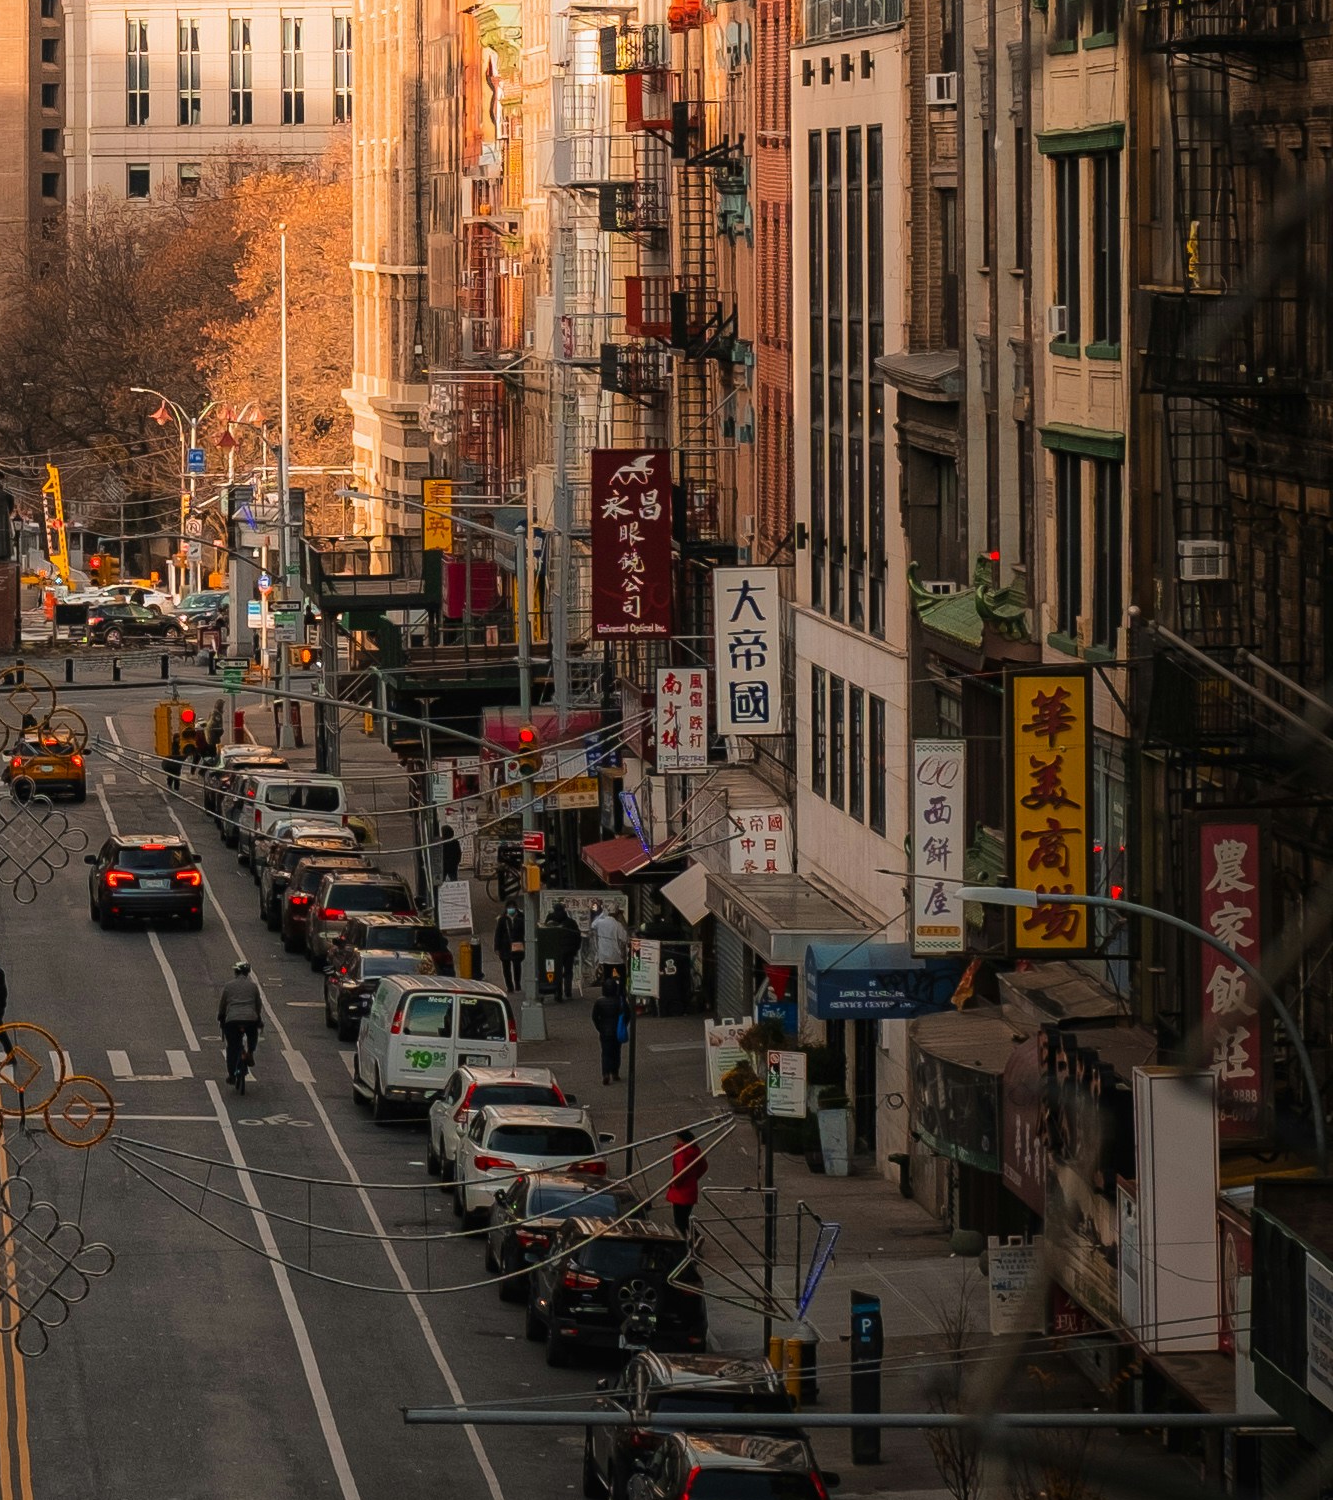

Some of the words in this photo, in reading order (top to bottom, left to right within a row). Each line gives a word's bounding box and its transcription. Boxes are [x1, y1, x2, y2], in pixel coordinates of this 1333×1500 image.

[600, 488, 662, 520] 永昌
[617, 521, 646, 619] 眼鏡公司
[597, 624, 629, 633] Universal
[630, 624, 653, 635] Optical
[726, 580, 770, 724] 大帝國
[916, 755, 959, 789] QQ
[1020, 686, 1083, 942] 華美商場
[923, 796, 952, 916] 西餅屋
